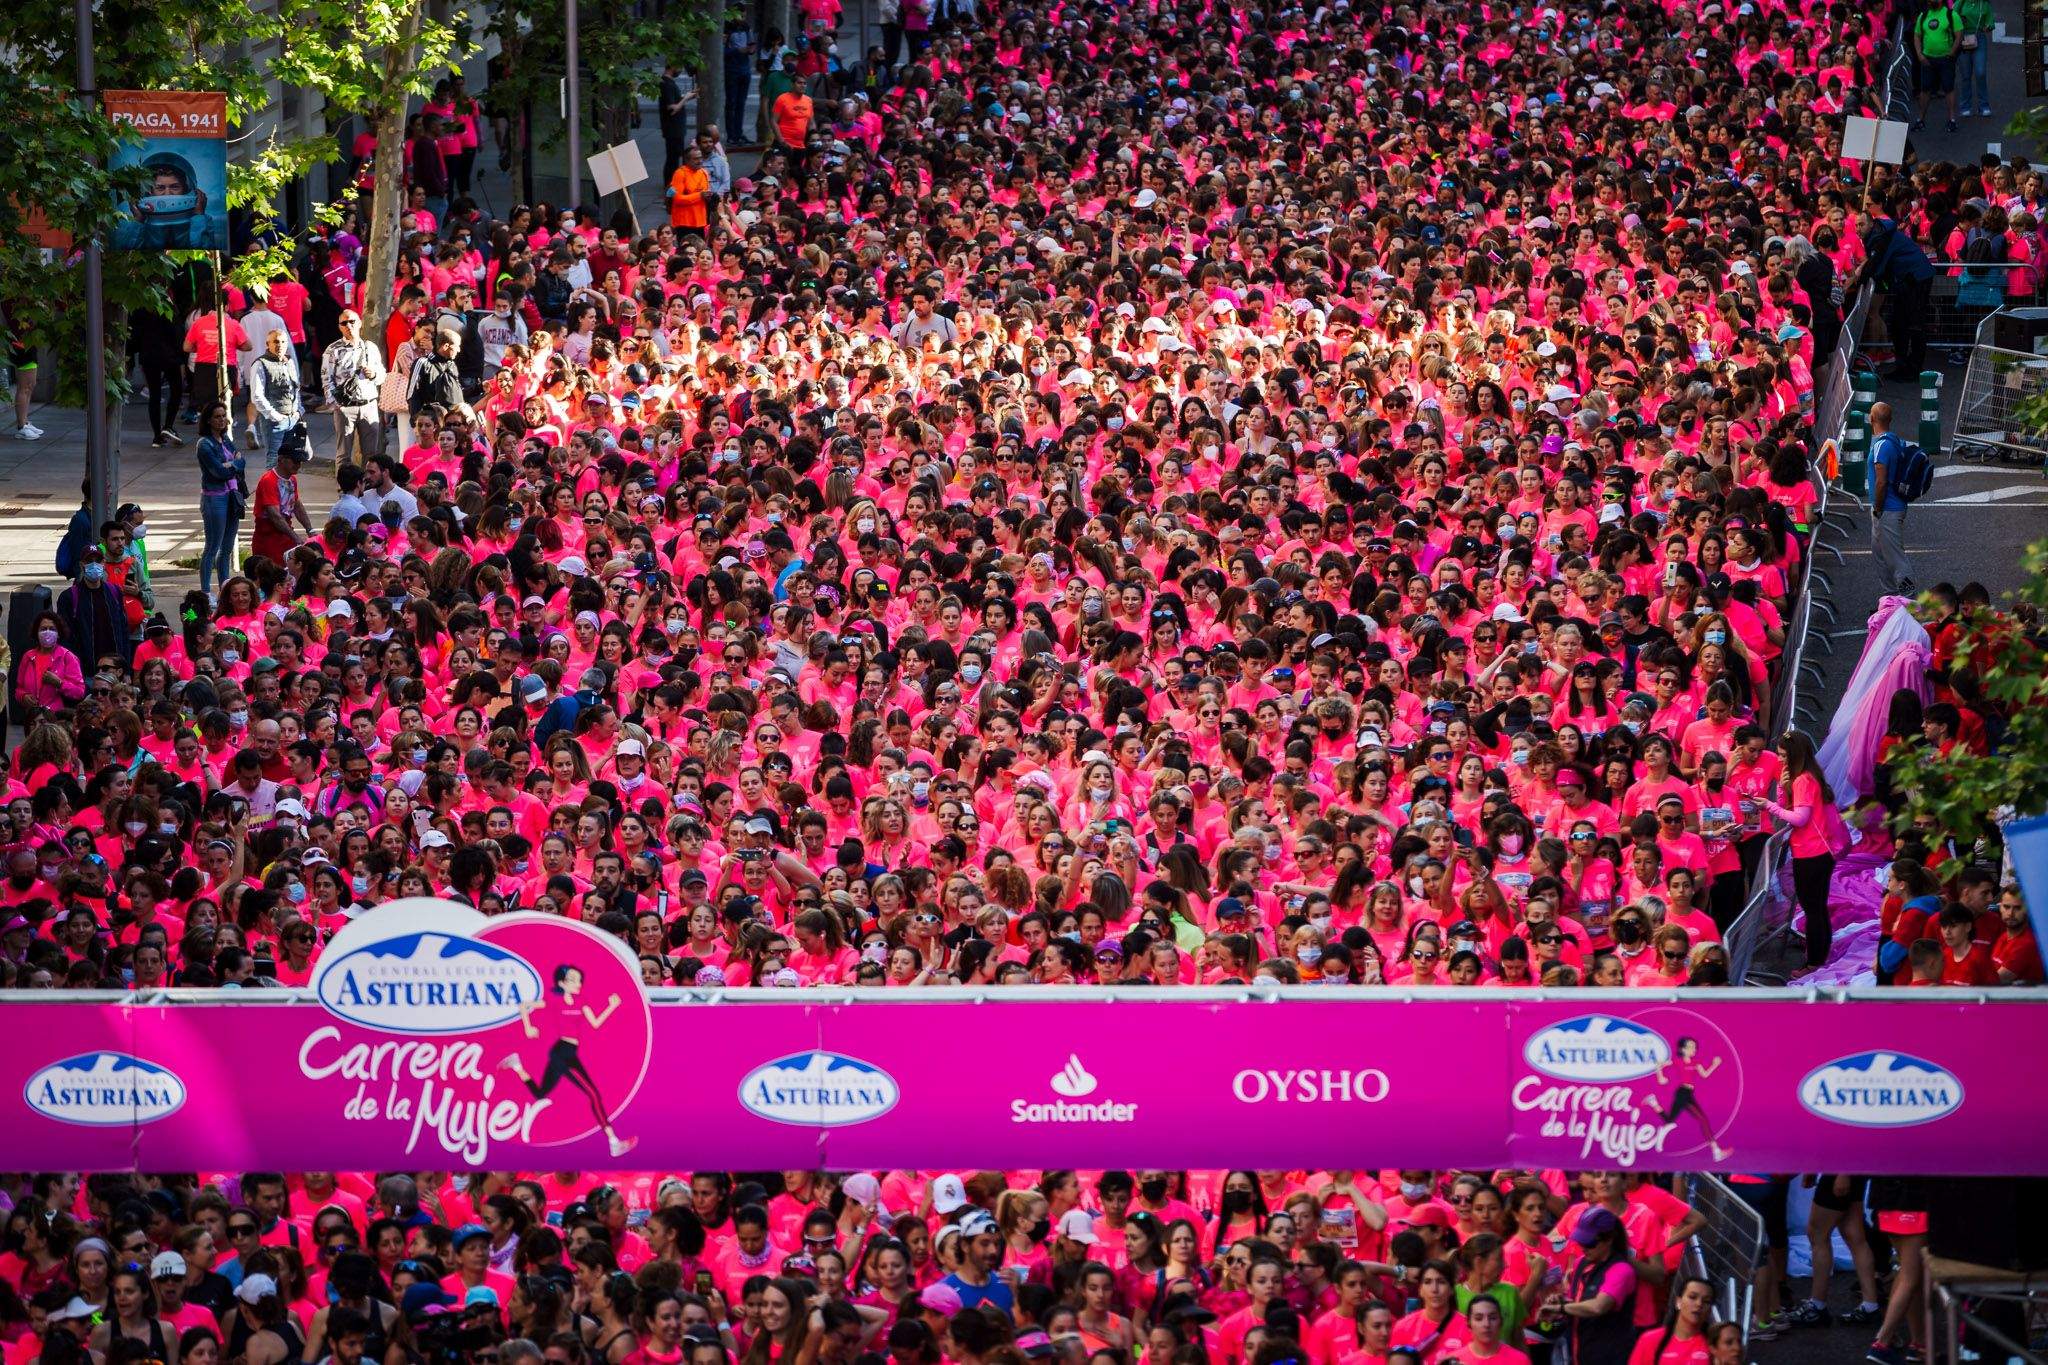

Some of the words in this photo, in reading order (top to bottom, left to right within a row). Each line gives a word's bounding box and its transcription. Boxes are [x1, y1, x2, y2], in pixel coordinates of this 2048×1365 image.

[112, 112, 176, 129] PRAGA,
[180, 112, 219, 128] 1941
[368, 966, 436, 976] CENTRAL
[446, 966, 517, 976] LECHERA
[298, 1025, 484, 1082] Carrera
[1232, 1068, 1391, 1104] OYSHO
[1511, 1075, 1633, 1112] Carrera
[343, 1082, 379, 1121] de
[385, 1081, 412, 1121] la
[405, 1074, 553, 1166] Mujer
[1010, 1099, 1139, 1123] Santander
[1540, 1111, 1565, 1137] de
[1567, 1111, 1586, 1137] la
[1579, 1107, 1678, 1167] Mujer
